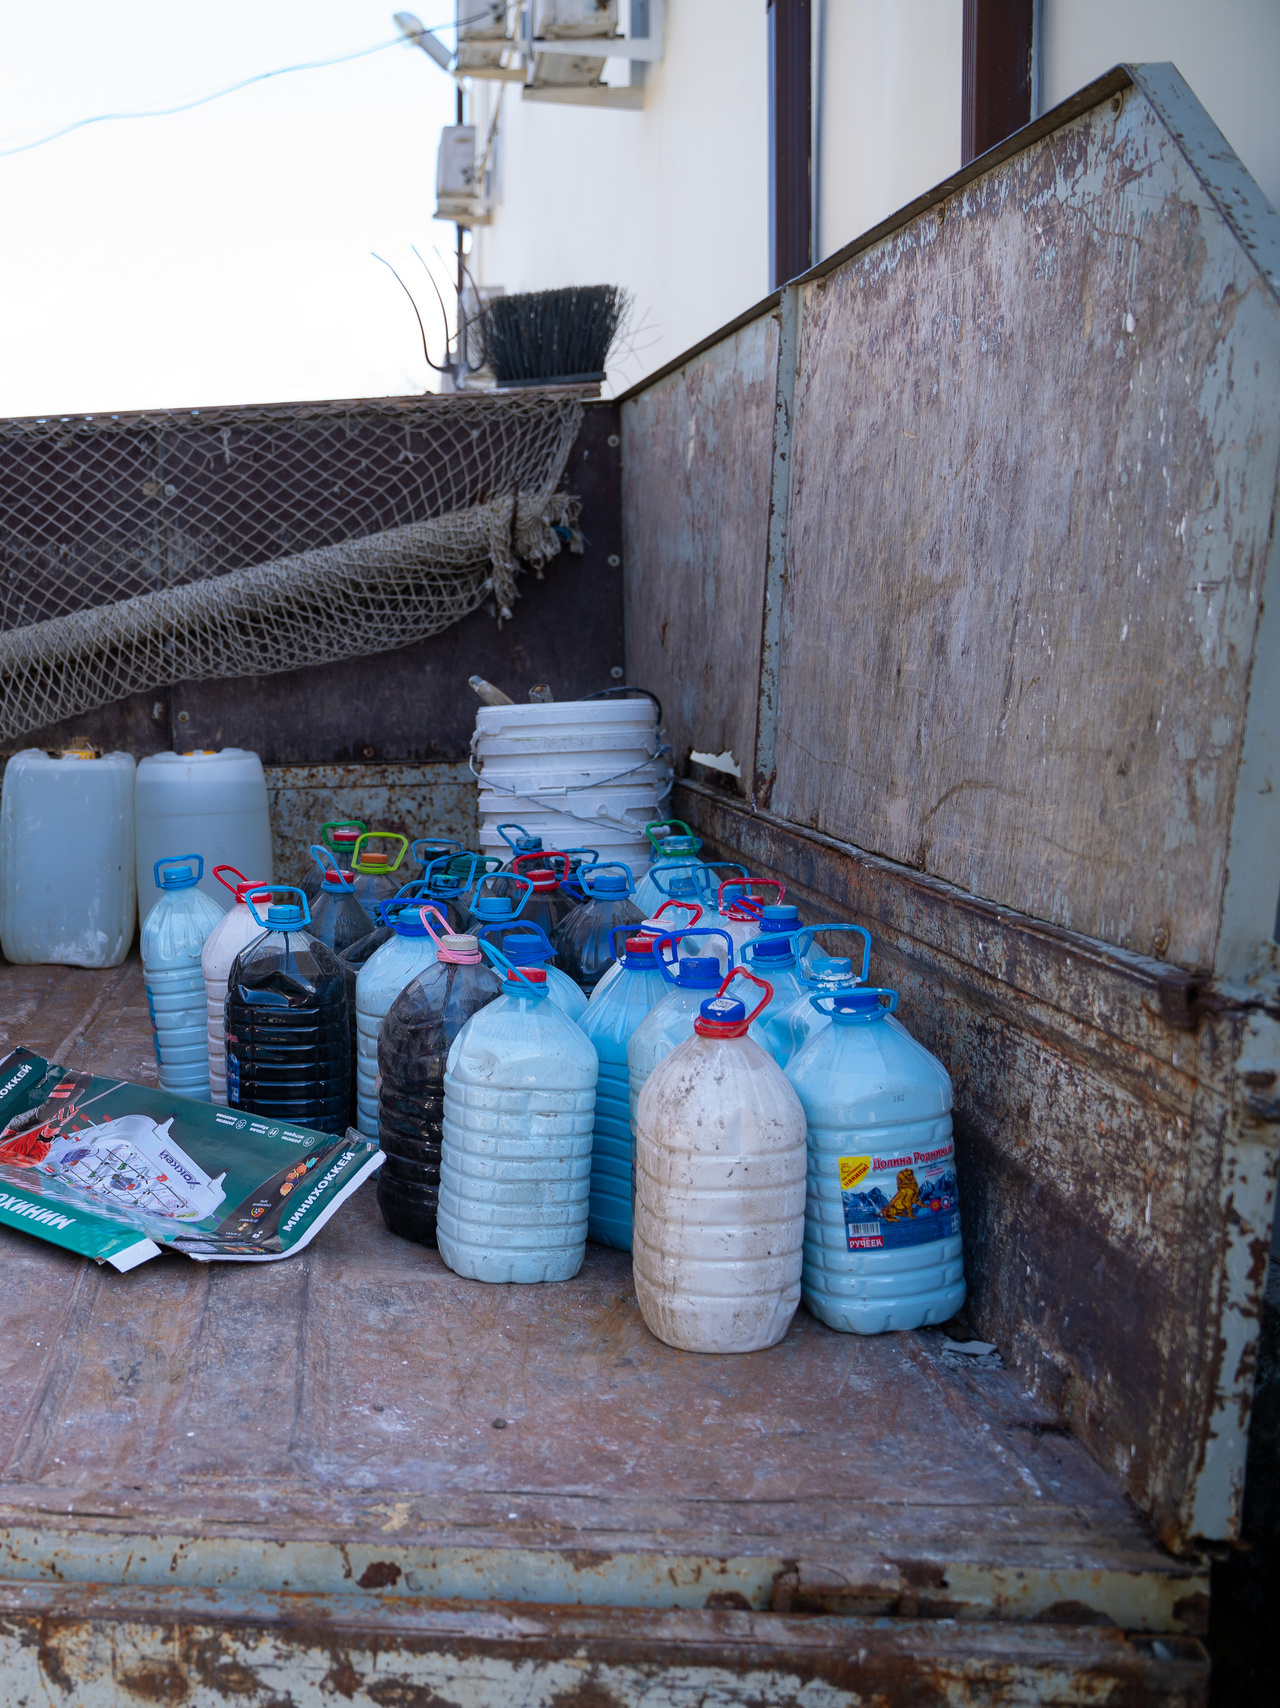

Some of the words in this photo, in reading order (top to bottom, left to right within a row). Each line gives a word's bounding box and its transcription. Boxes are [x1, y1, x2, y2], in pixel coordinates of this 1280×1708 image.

[872, 1157, 912, 1172] Долина
[913, 1145, 953, 1163] Родников
[844, 1163, 870, 1188] накипи!
[282, 1151, 356, 1232] МИНИХОККЕЙ
[849, 1238, 883, 1249] РУЧЕЕК
